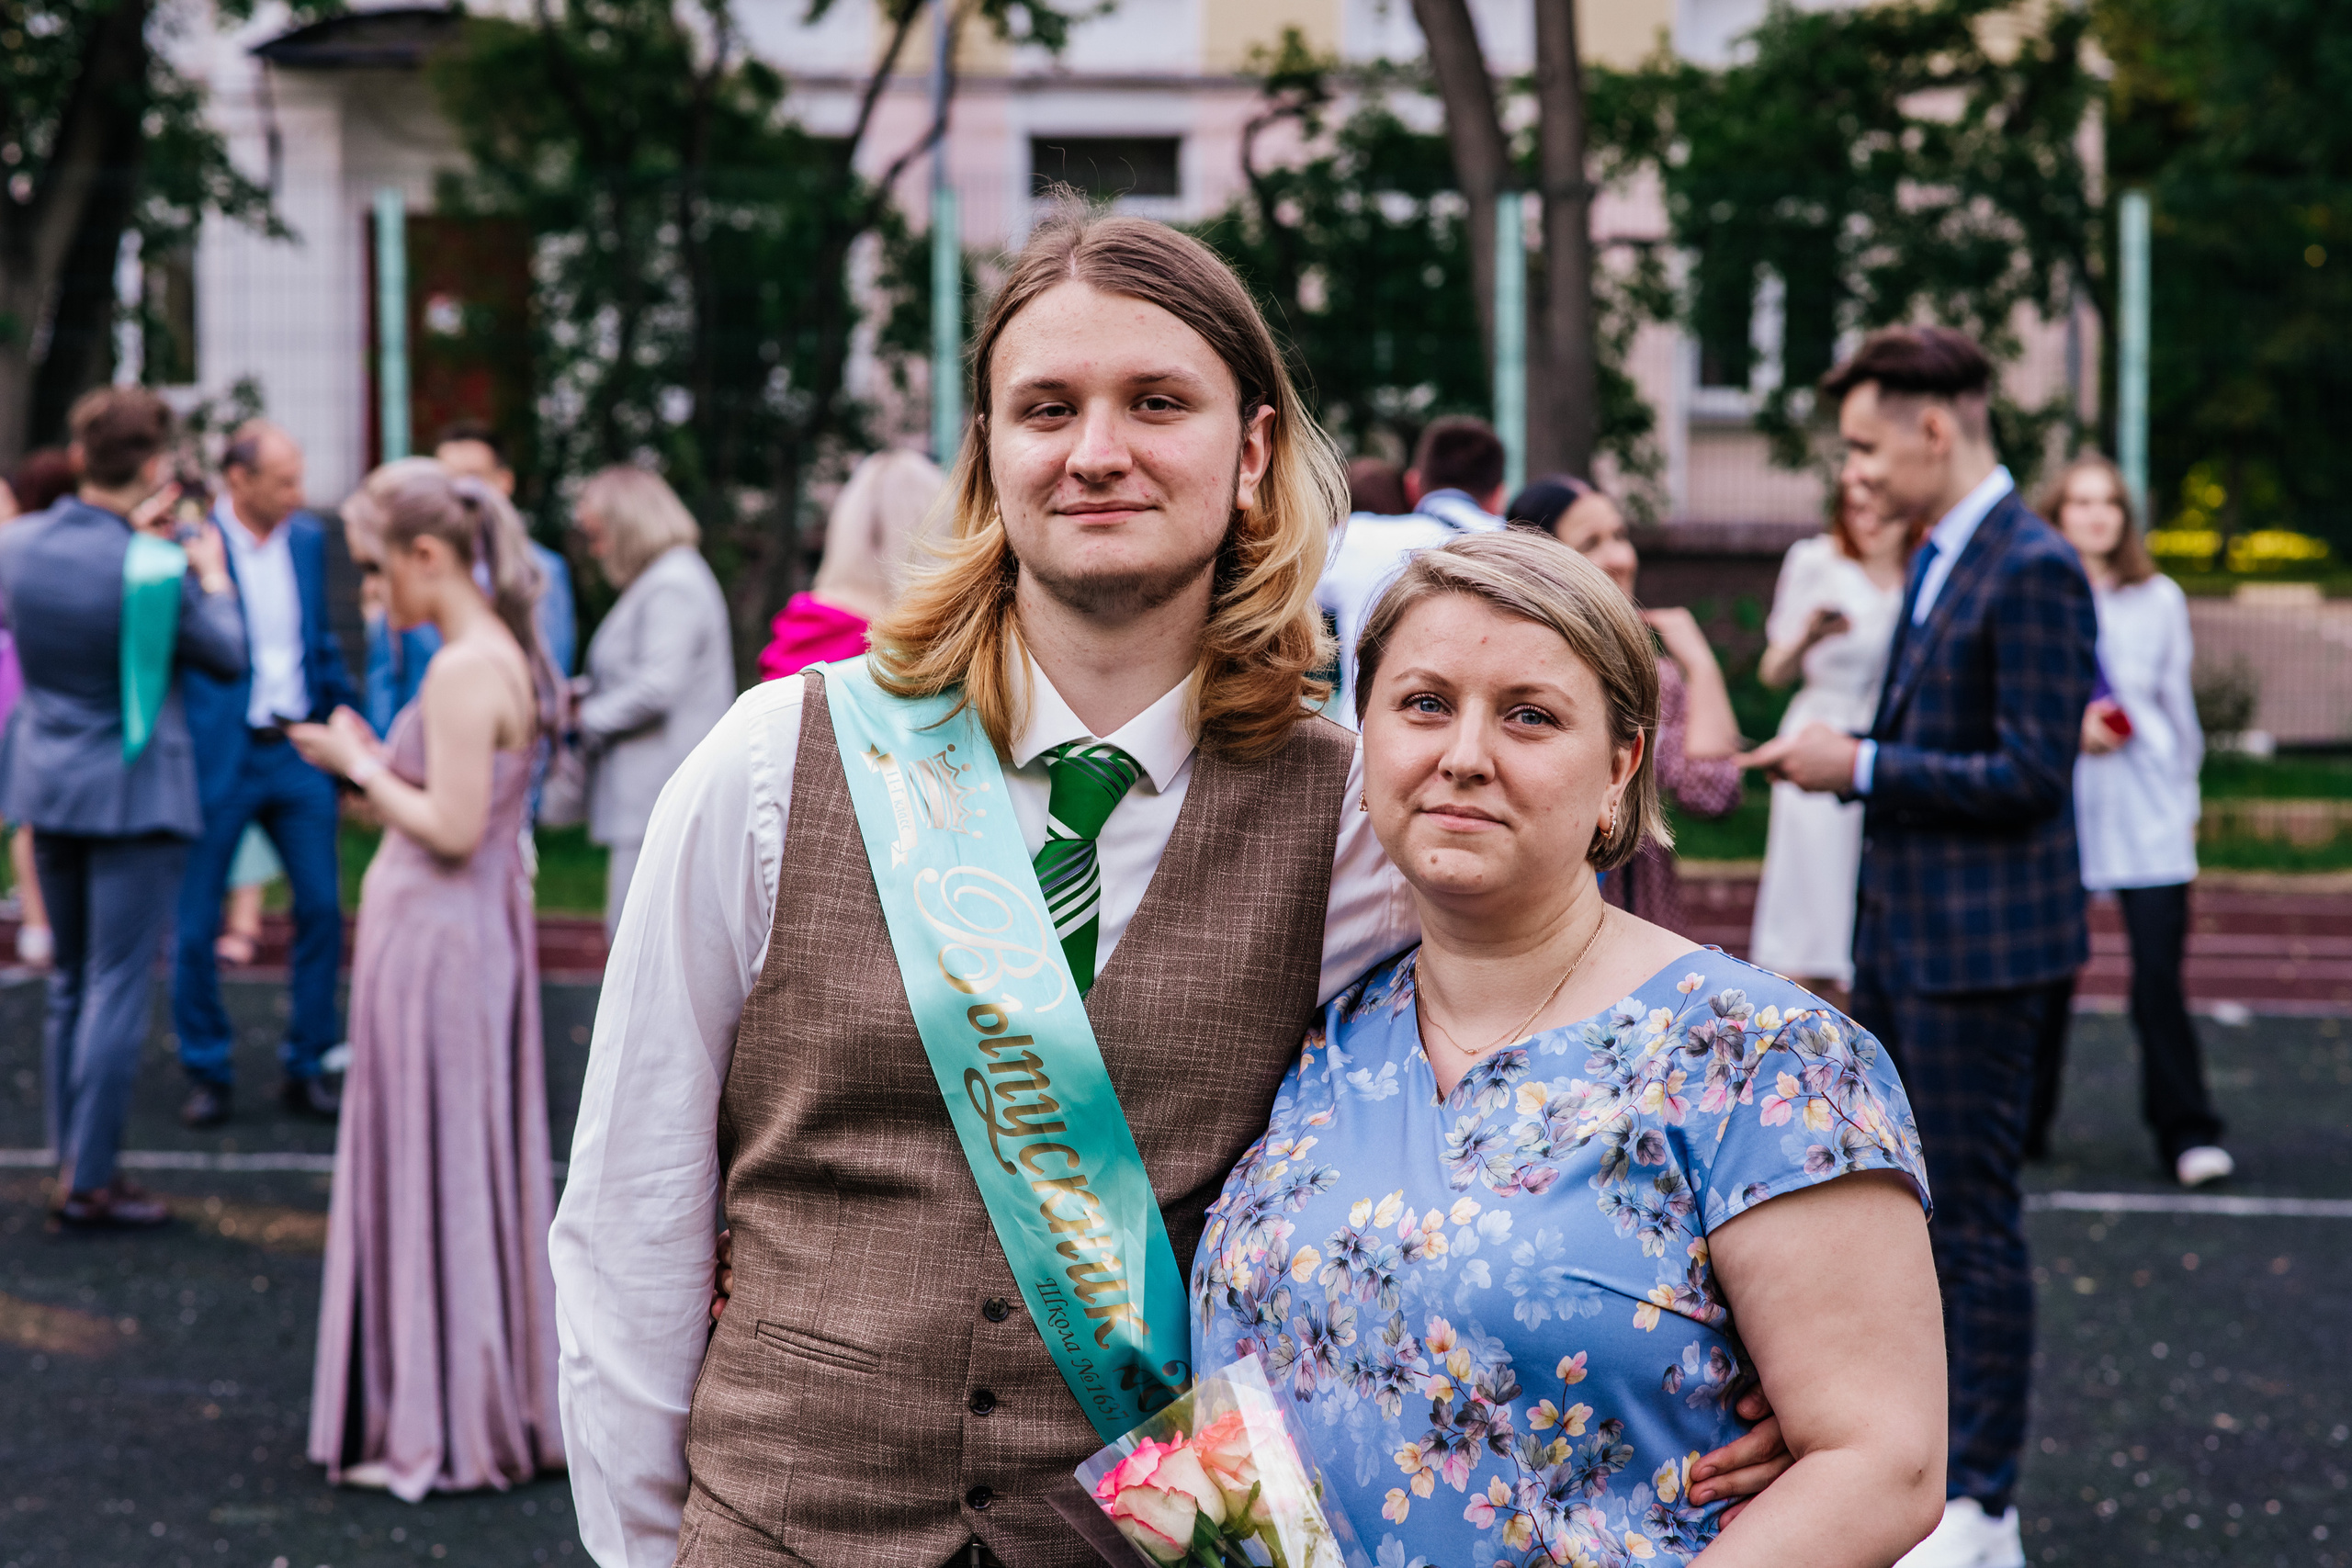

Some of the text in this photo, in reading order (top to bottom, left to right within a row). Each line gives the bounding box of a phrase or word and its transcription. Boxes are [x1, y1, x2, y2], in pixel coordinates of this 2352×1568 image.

[894, 799, 910, 830] класс
[914, 865, 1150, 1349] Выпускник
[1035, 1278, 1081, 1355] Школа
